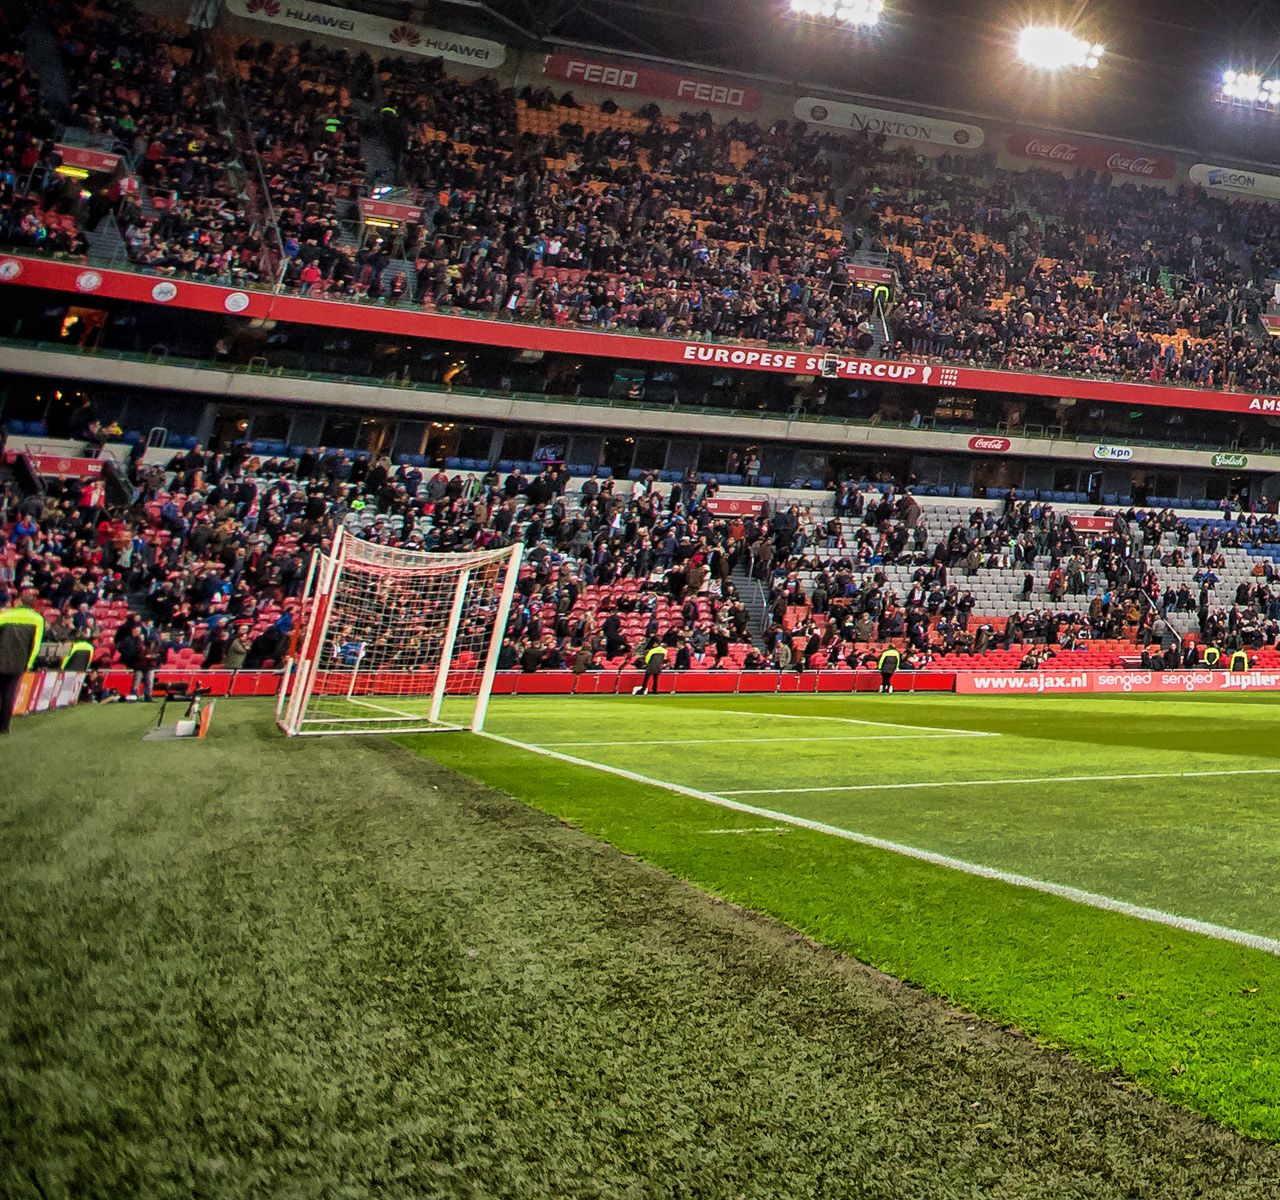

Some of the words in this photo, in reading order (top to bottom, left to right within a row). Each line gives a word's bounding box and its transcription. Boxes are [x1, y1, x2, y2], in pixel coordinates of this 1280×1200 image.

[285, 8, 355, 32] HUAWEI
[424, 38, 490, 61] HUAWEI
[566, 61, 638, 89] FEBO
[677, 79, 745, 106] FEBO
[850, 111, 931, 140] NORTON
[683, 345, 797, 369] EUROPESE
[1110, 447, 1130, 458] kpn
[974, 673, 1088, 692] www.ajax.nl
[1098, 673, 1152, 691] sengled
[1161, 672, 1214, 691] sengled
[1220, 671, 1280, 689] Jupiler
